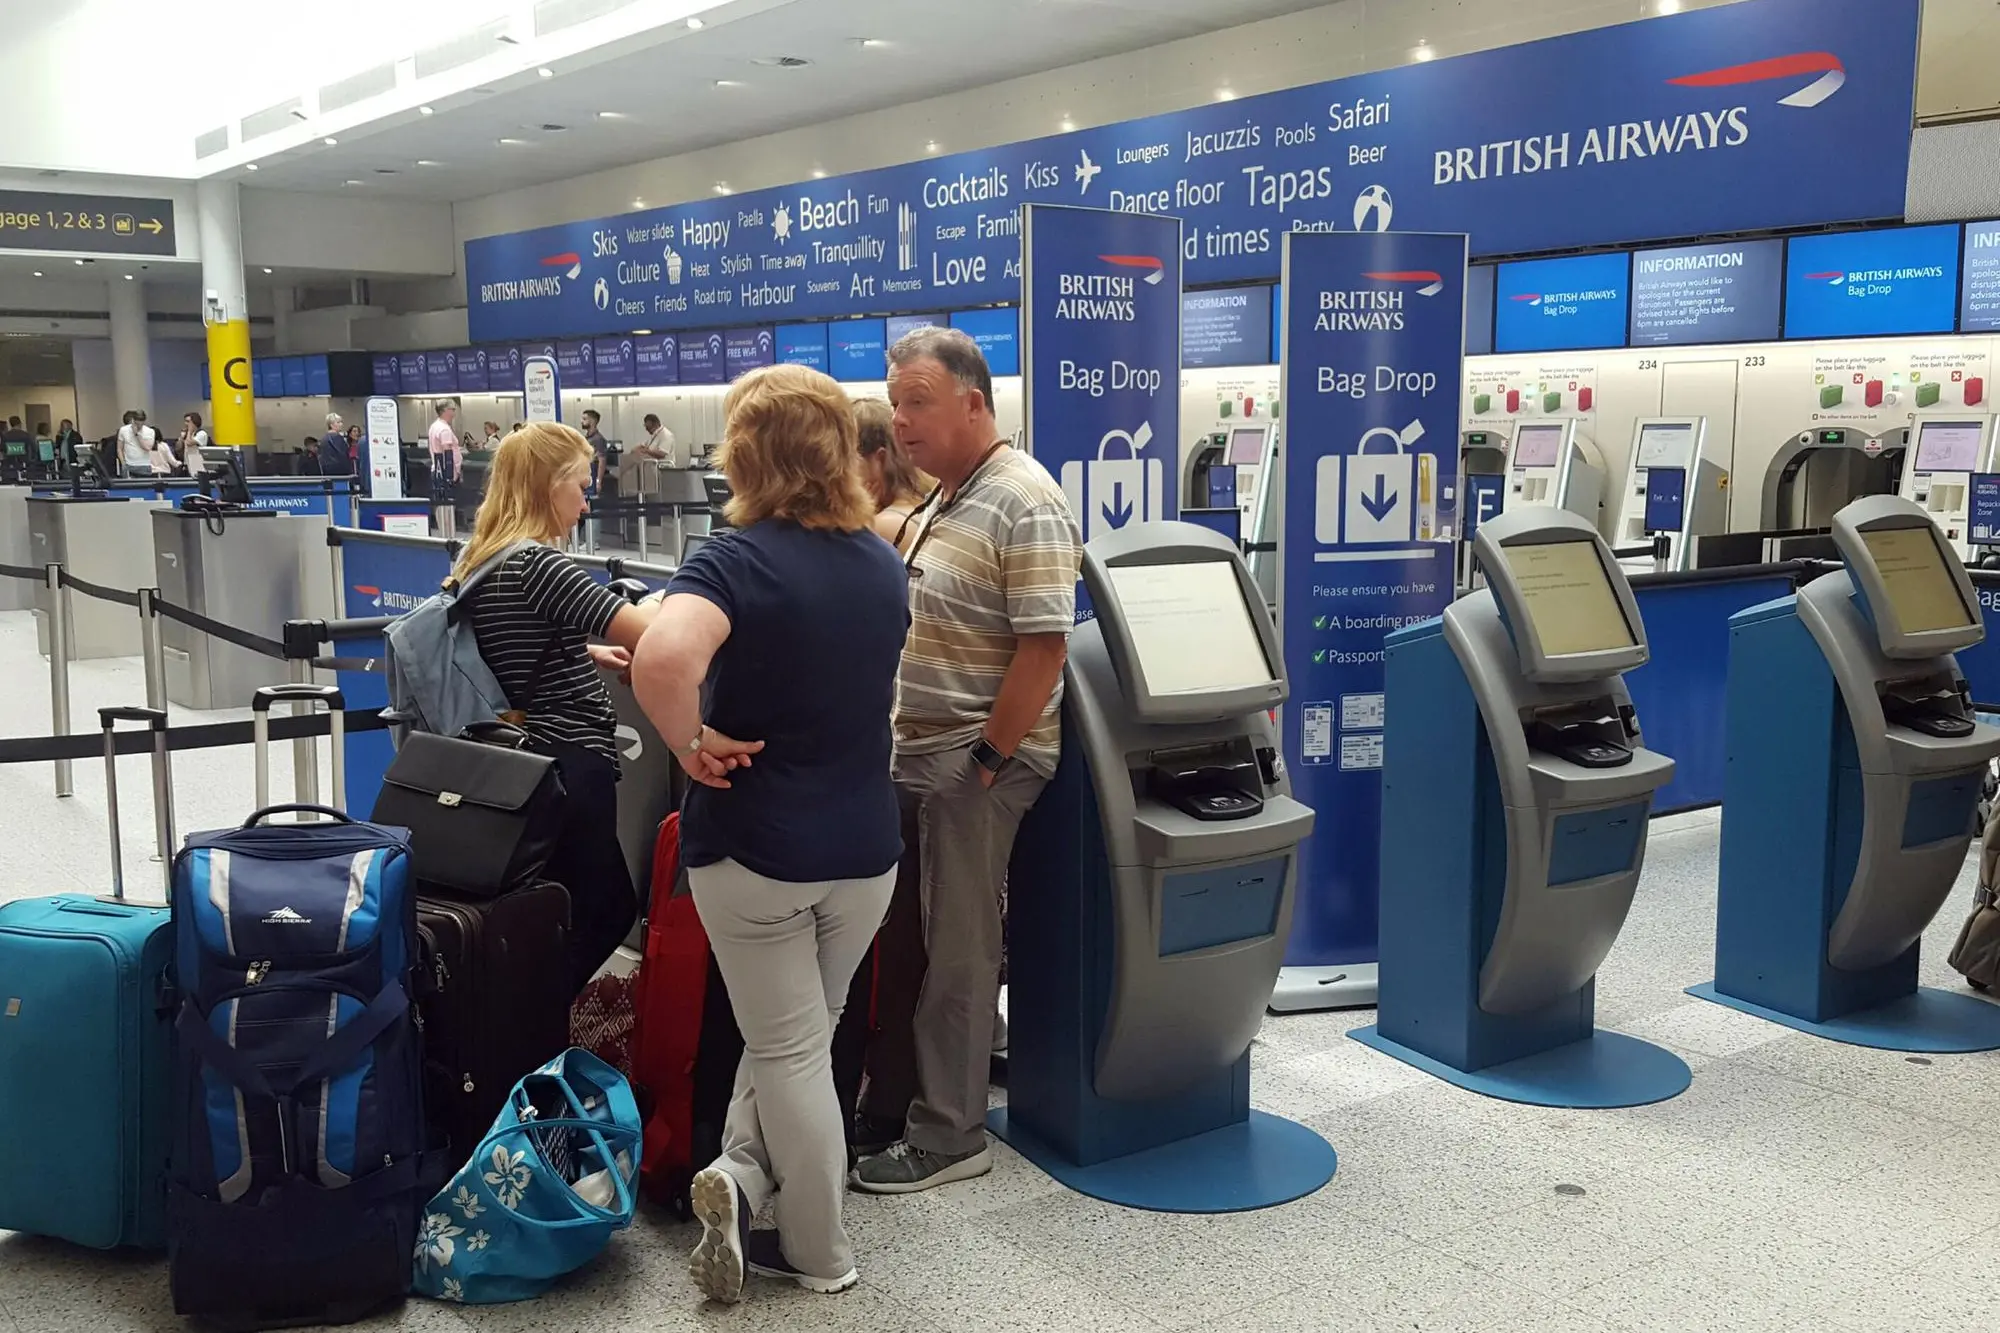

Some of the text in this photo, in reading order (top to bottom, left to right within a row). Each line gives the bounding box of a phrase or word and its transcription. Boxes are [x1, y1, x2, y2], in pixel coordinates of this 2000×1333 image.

[1328, 94, 1390, 133] Safari
[1185, 120, 1261, 163] Jacuzzis
[1276, 122, 1316, 148] Pools
[1117, 141, 1169, 165] Loungers
[1348, 143, 1387, 166] Beer
[1433, 106, 1749, 185] BRITISH AIRWAYS
[1025, 162, 1059, 190] Kiss
[923, 166, 1009, 209] Cocktails
[1110, 178, 1225, 212] Dance floor
[1241, 166, 1332, 213] Tapas
[800, 189, 859, 231] Beach
[868, 195, 889, 215] Fun
[46, 211, 59, 229] 1,
[63, 212, 74, 228] 2
[78, 212, 92, 229] &
[95, 213, 106, 229] 3
[738, 209, 764, 228] Paella
[1292, 219, 1335, 232] Party
[626, 224, 675, 244] Water slides
[683, 218, 731, 250] Happy
[936, 225, 967, 241] Escape
[1205, 228, 1270, 257] times
[593, 230, 618, 257] Skis
[813, 234, 886, 267] Tranquillity
[691, 261, 710, 277] Heat
[721, 253, 752, 276] Stylish
[760, 252, 808, 271] Time away
[933, 252, 987, 287] Love
[1639, 252, 1743, 274] INFORMATION
[1972, 257, 1999, 267] British
[617, 261, 660, 286] Culture
[1848, 266, 1943, 282] BRITISH AIRWAYS
[481, 276, 561, 303] BRITISH AIRWAYS
[806, 278, 840, 294] Souvenirs
[850, 272, 875, 298] Art
[882, 276, 922, 293] Memories
[1060, 274, 1133, 298] BRITISH
[1639, 281, 1660, 290] British
[1660, 280, 1687, 289] Airways
[1688, 277, 1710, 286] would
[1711, 277, 1724, 285] like
[1672, 290, 1682, 298] for
[1683, 289, 1695, 297] the
[1696, 287, 1721, 296] current
[1848, 284, 1892, 297] Bag Drop
[654, 293, 688, 314] Friends
[694, 287, 732, 306] Road trip
[741, 283, 796, 308] Harbour
[1183, 296, 1247, 311] INFORMATION
[1320, 291, 1403, 310] BRITISH
[1544, 289, 1616, 304] BRITISH AIRWAYS
[1675, 299, 1712, 309] Passengers
[615, 298, 646, 317] Cheers
[1055, 299, 1136, 322] AIRWAYS
[1544, 305, 1577, 317] Bag Drop
[1664, 309, 1678, 317] that
[1688, 305, 1710, 317] flights
[1711, 304, 1735, 314] before
[1969, 301, 1989, 311] 6pm
[1314, 312, 1404, 331] AIRWAYS
[727, 349, 741, 358] FREE
[1745, 356, 1766, 367] 233
[1834, 357, 1848, 365] place
[1850, 357, 1862, 365] your
[1863, 355, 1886, 364] luggage
[1962, 353, 1986, 361] luggage
[224, 357, 249, 390] C
[1638, 360, 1658, 370] 234
[1060, 360, 1161, 397] Bag Drop
[1317, 366, 1437, 399] Bag Drop
[268, 498, 309, 508] AIRWAYS
[1313, 582, 1436, 597] Please ensure you have
[383, 591, 412, 610] BRITISH
[1974, 587, 2000, 612] ag
[1073, 608, 1094, 620] ase
[1329, 616, 1341, 630] A
[1345, 614, 1402, 630] boarding
[1329, 650, 1386, 665] Passport
